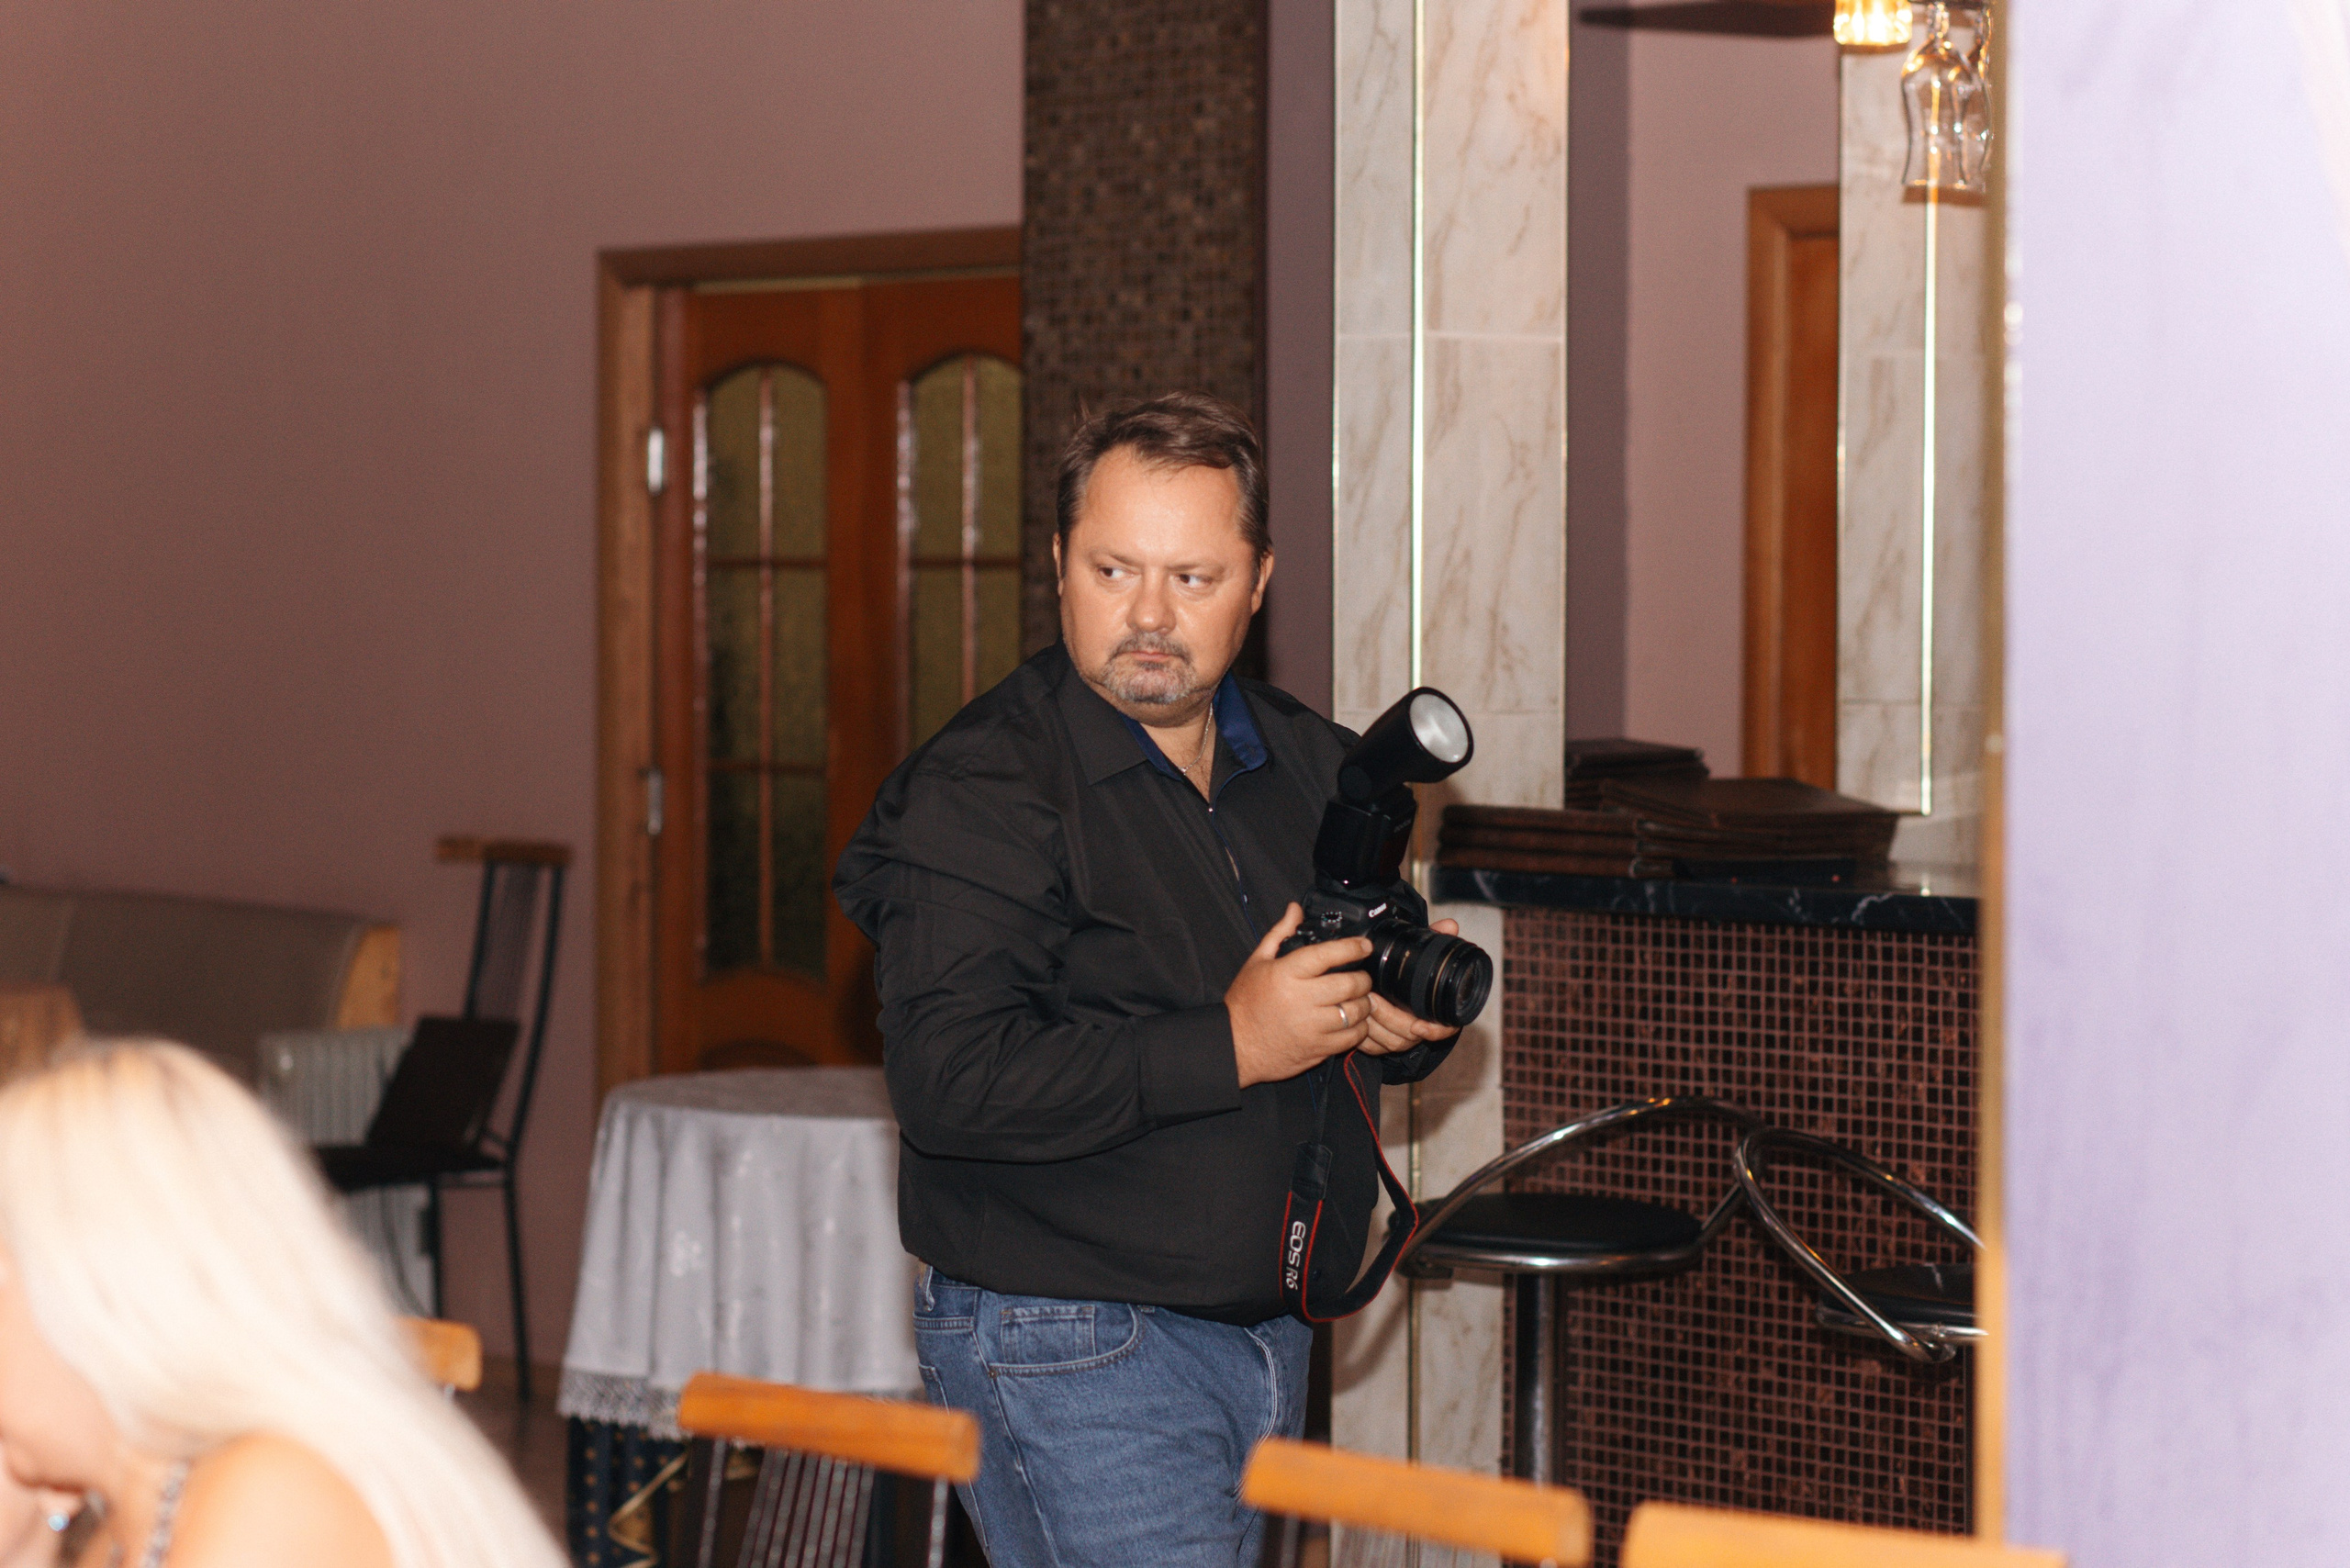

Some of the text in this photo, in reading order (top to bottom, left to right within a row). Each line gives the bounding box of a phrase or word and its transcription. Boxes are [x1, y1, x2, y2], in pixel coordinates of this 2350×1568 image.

[1368, 902, 1387, 918] Canon
[1286, 1221, 1306, 1291] EOS R6
